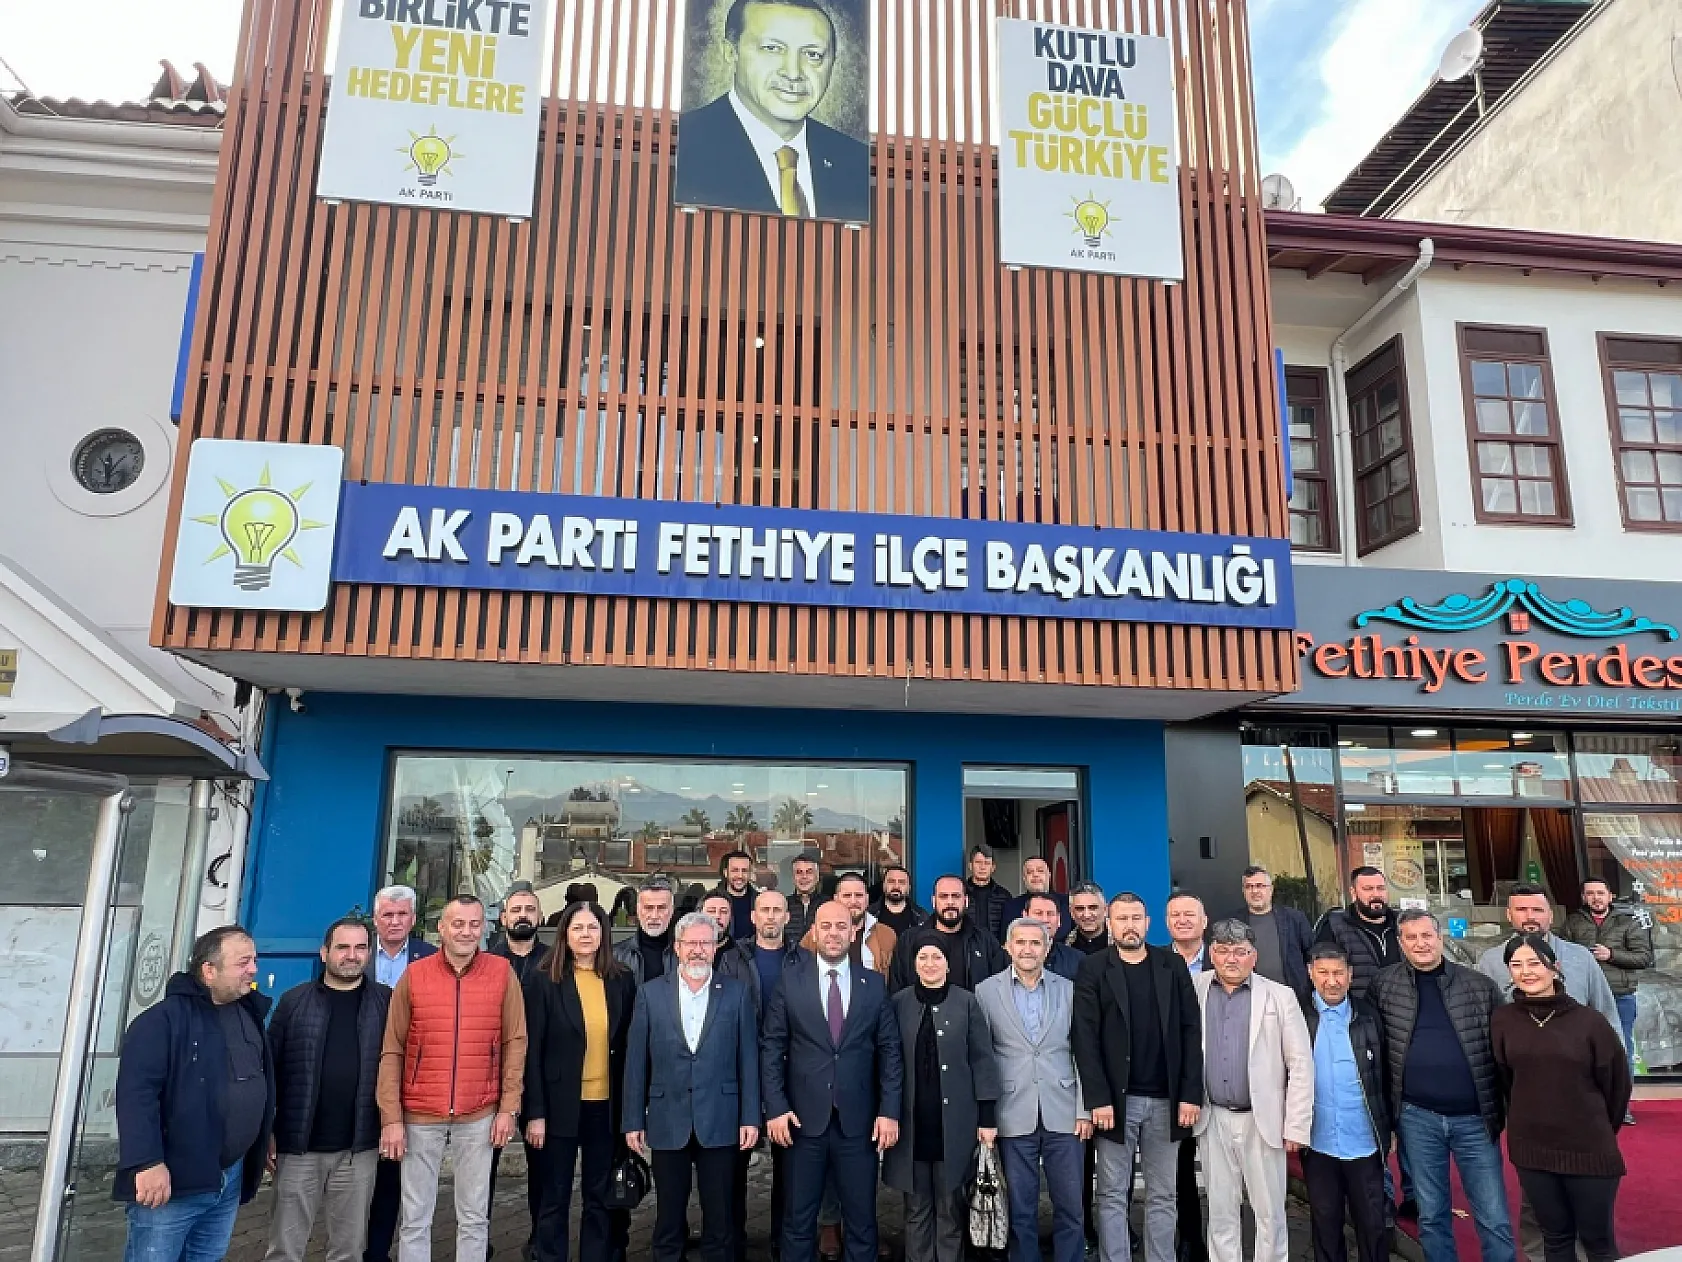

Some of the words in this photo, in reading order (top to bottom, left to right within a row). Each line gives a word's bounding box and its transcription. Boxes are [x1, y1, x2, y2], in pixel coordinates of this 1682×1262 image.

[1033, 27, 1136, 68] KUTLU
[347, 66, 526, 114] HEDEFLERE
[1048, 61, 1125, 99] DAVA
[398, 188, 417, 198] AK
[1070, 249, 1085, 259] AK
[382, 506, 472, 562] AK
[985, 540, 1278, 606] BAŞKANLIĞI
[1504, 692, 1552, 706] Perde
[1559, 693, 1582, 707] Ev
[1587, 693, 1622, 708] Otel
[1627, 695, 1682, 711] Tekstil
